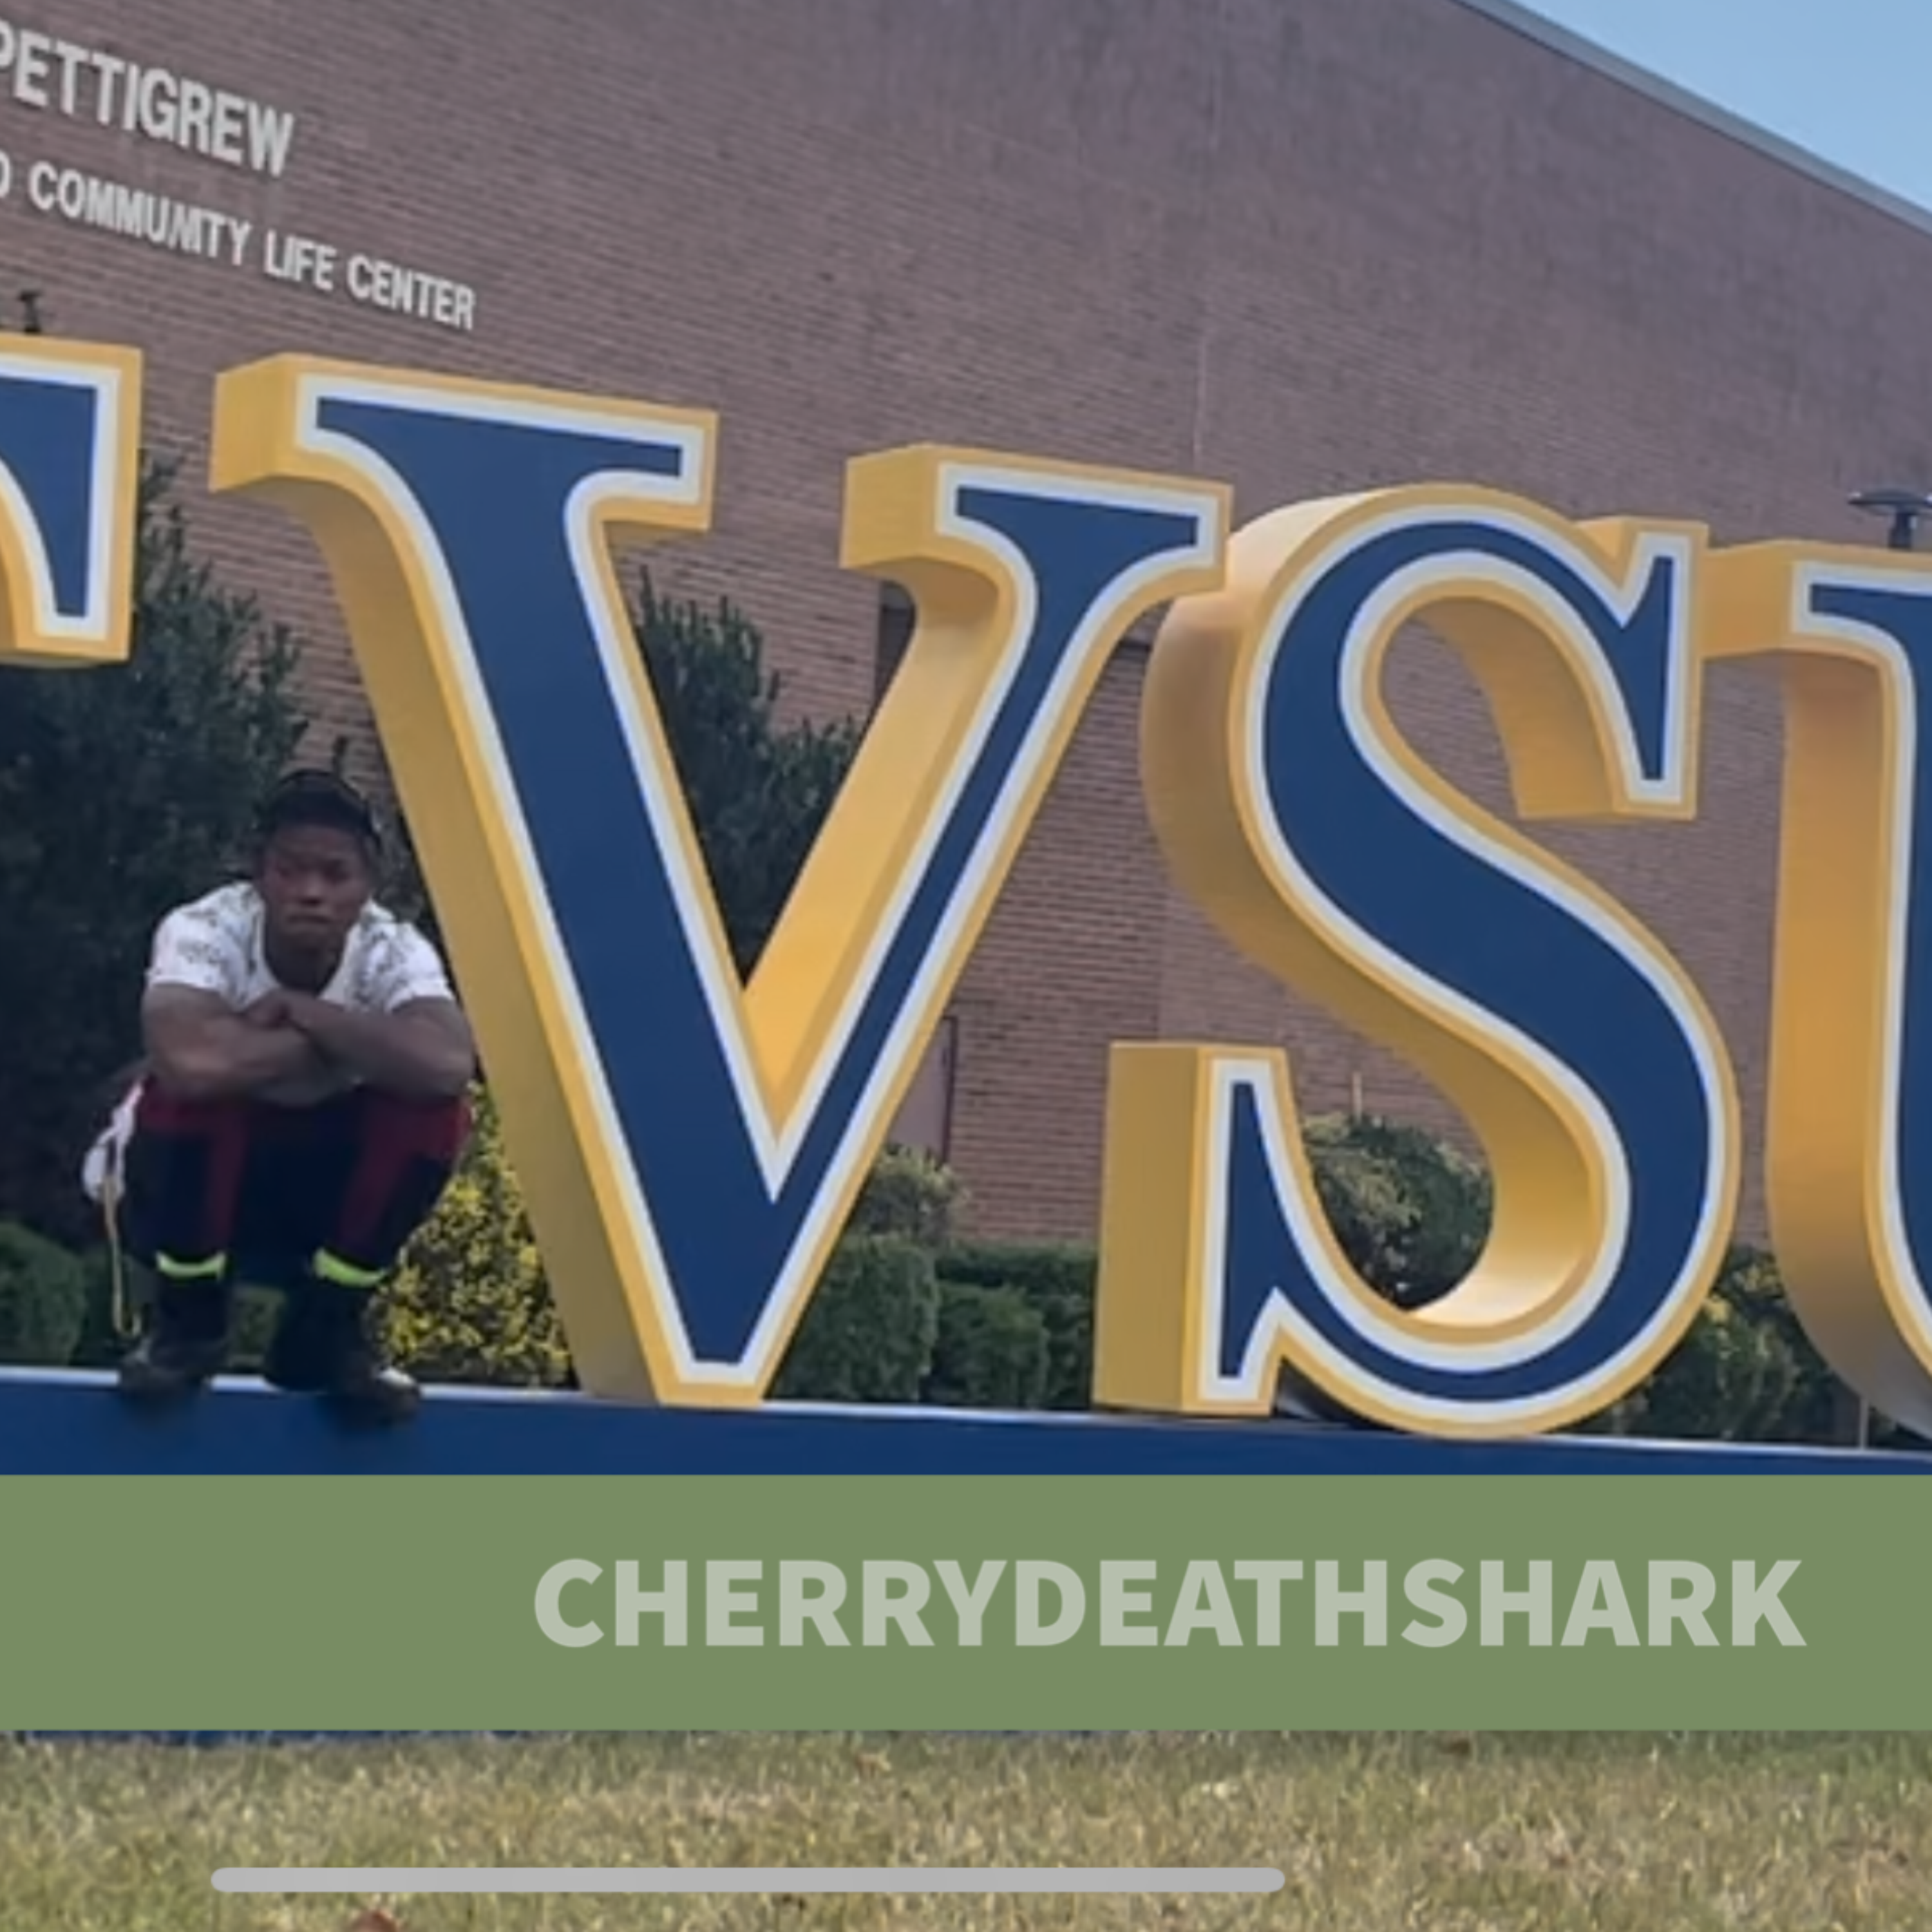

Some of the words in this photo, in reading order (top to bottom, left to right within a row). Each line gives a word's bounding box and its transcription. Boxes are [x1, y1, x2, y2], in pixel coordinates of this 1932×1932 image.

[28, 160, 252, 266] COMMUNITY
[263, 230, 337, 290] LIFE
[346, 254, 475, 330] CENTER
